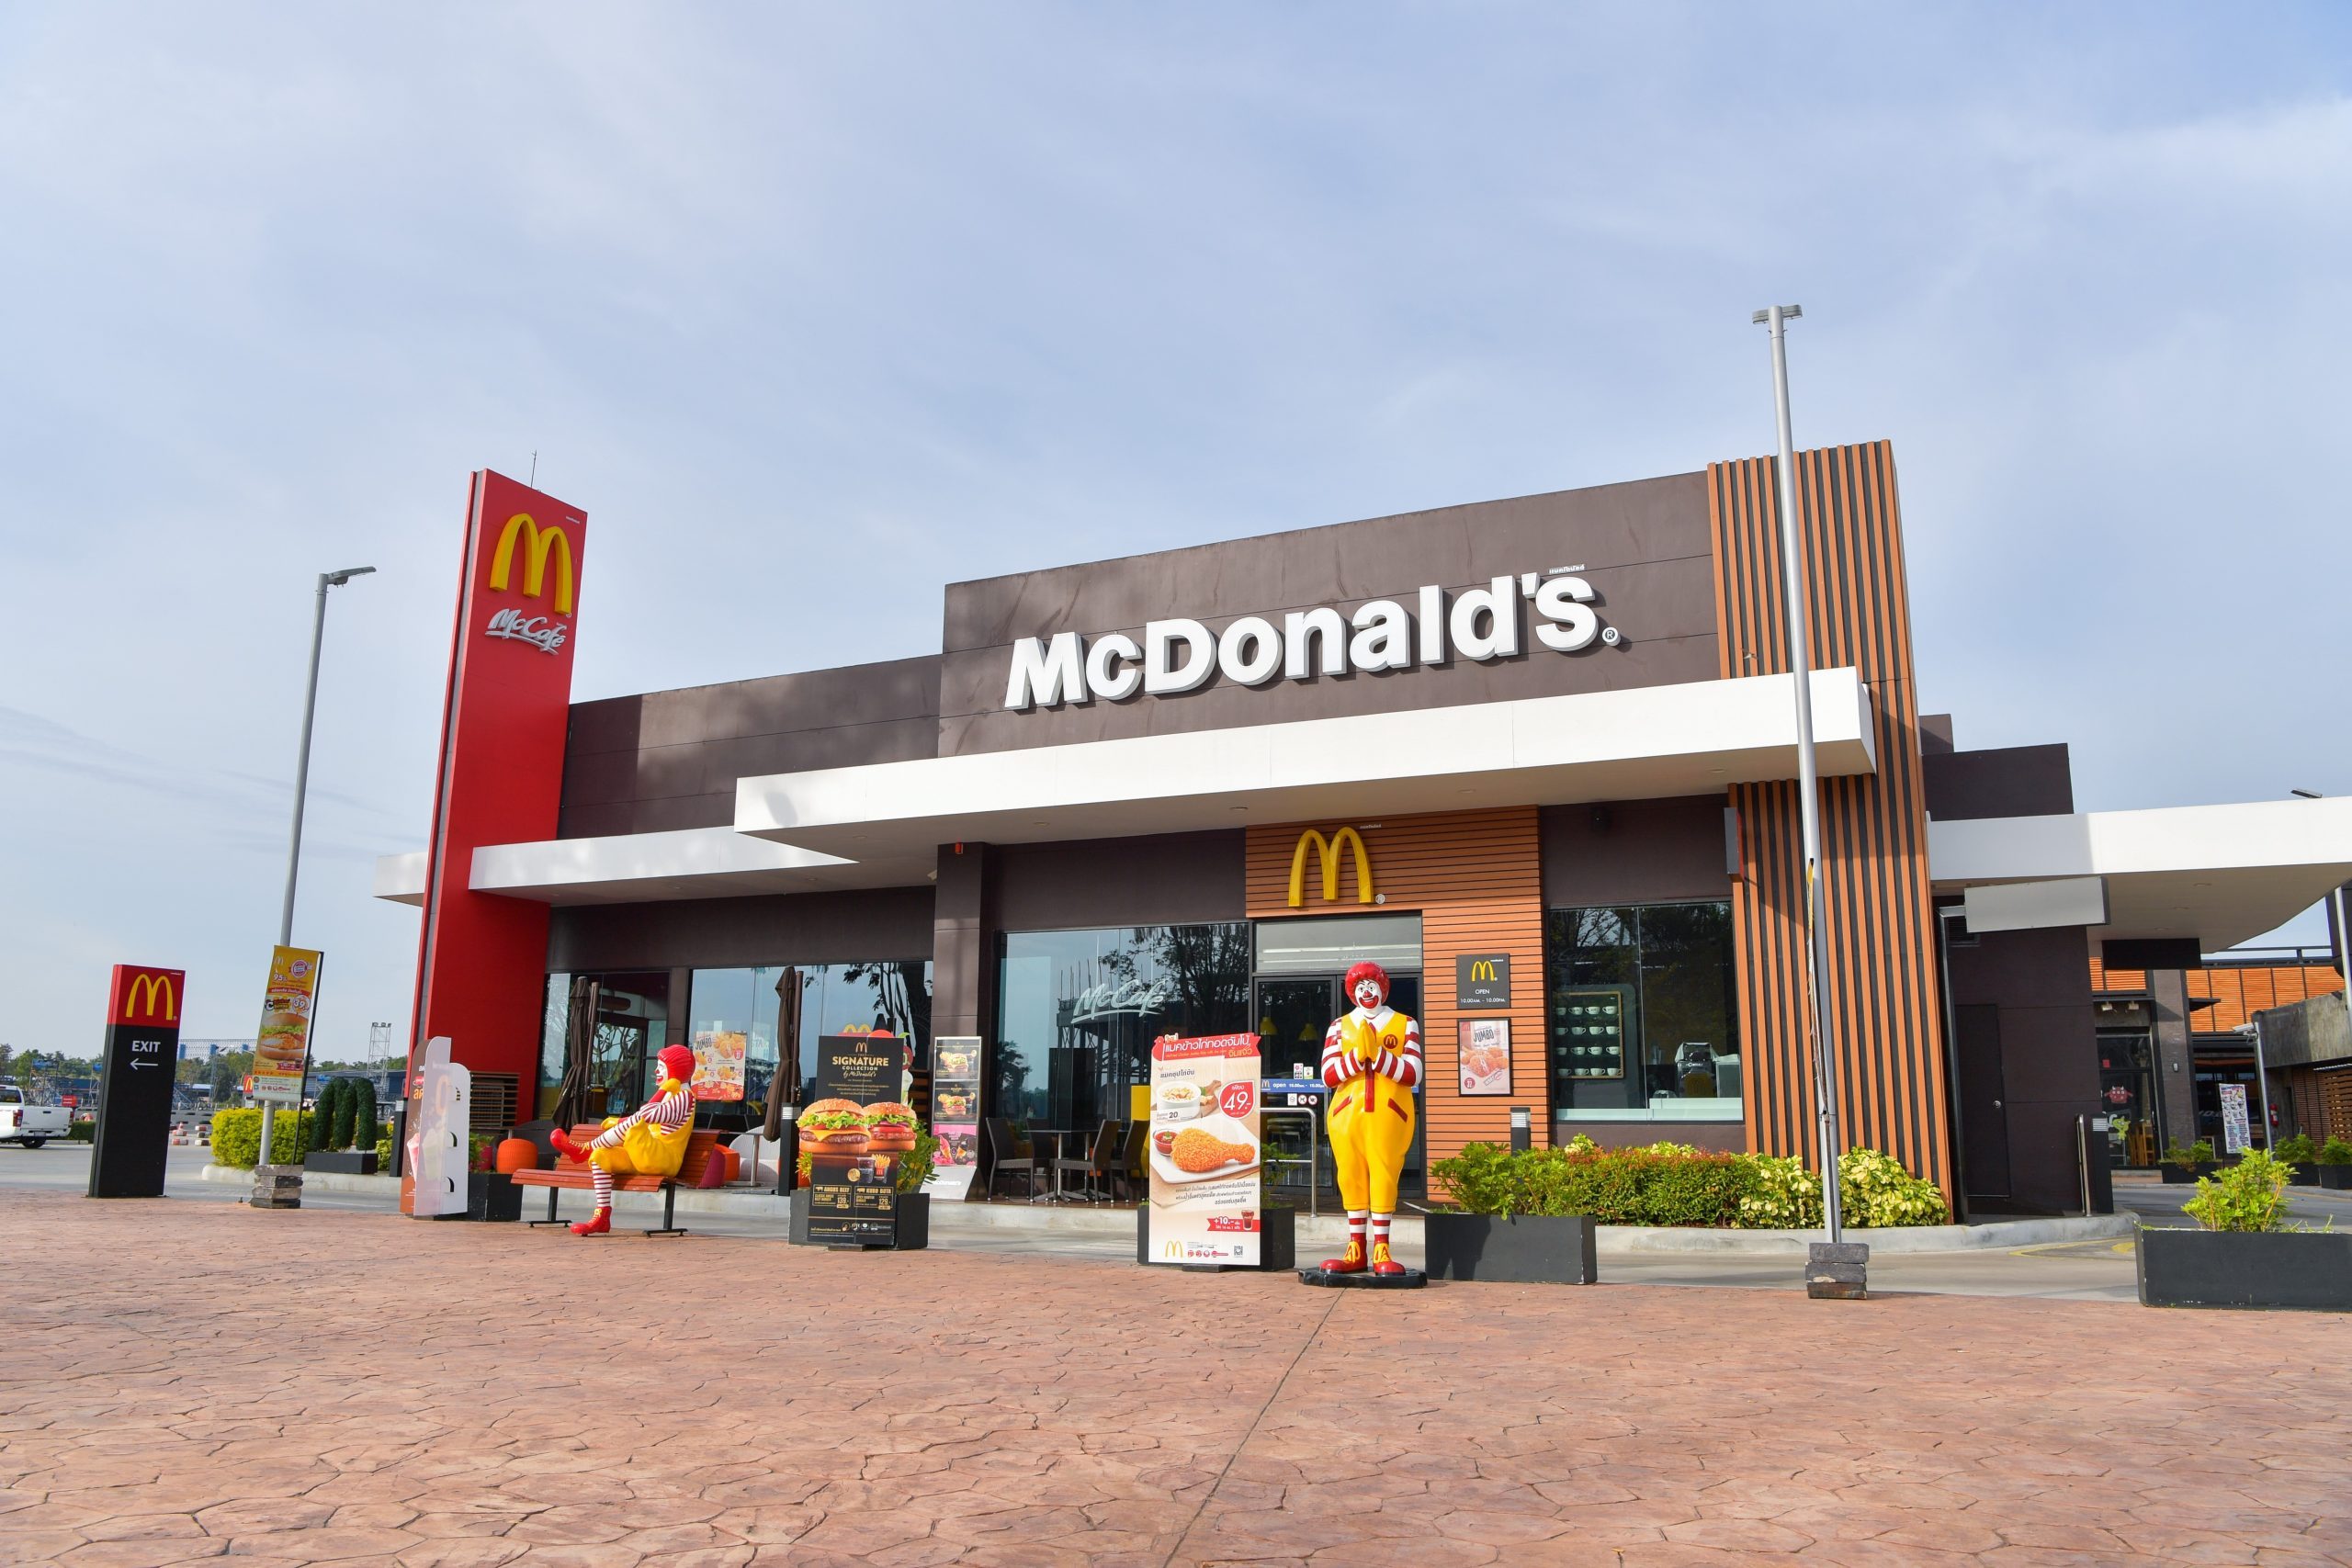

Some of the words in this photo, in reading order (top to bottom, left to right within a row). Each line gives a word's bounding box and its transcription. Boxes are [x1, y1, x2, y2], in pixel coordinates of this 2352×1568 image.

[1004, 572, 1600, 712] McDonald's
[131, 1040, 161, 1053] EXIT
[832, 1056, 888, 1066] SIGNATURE
